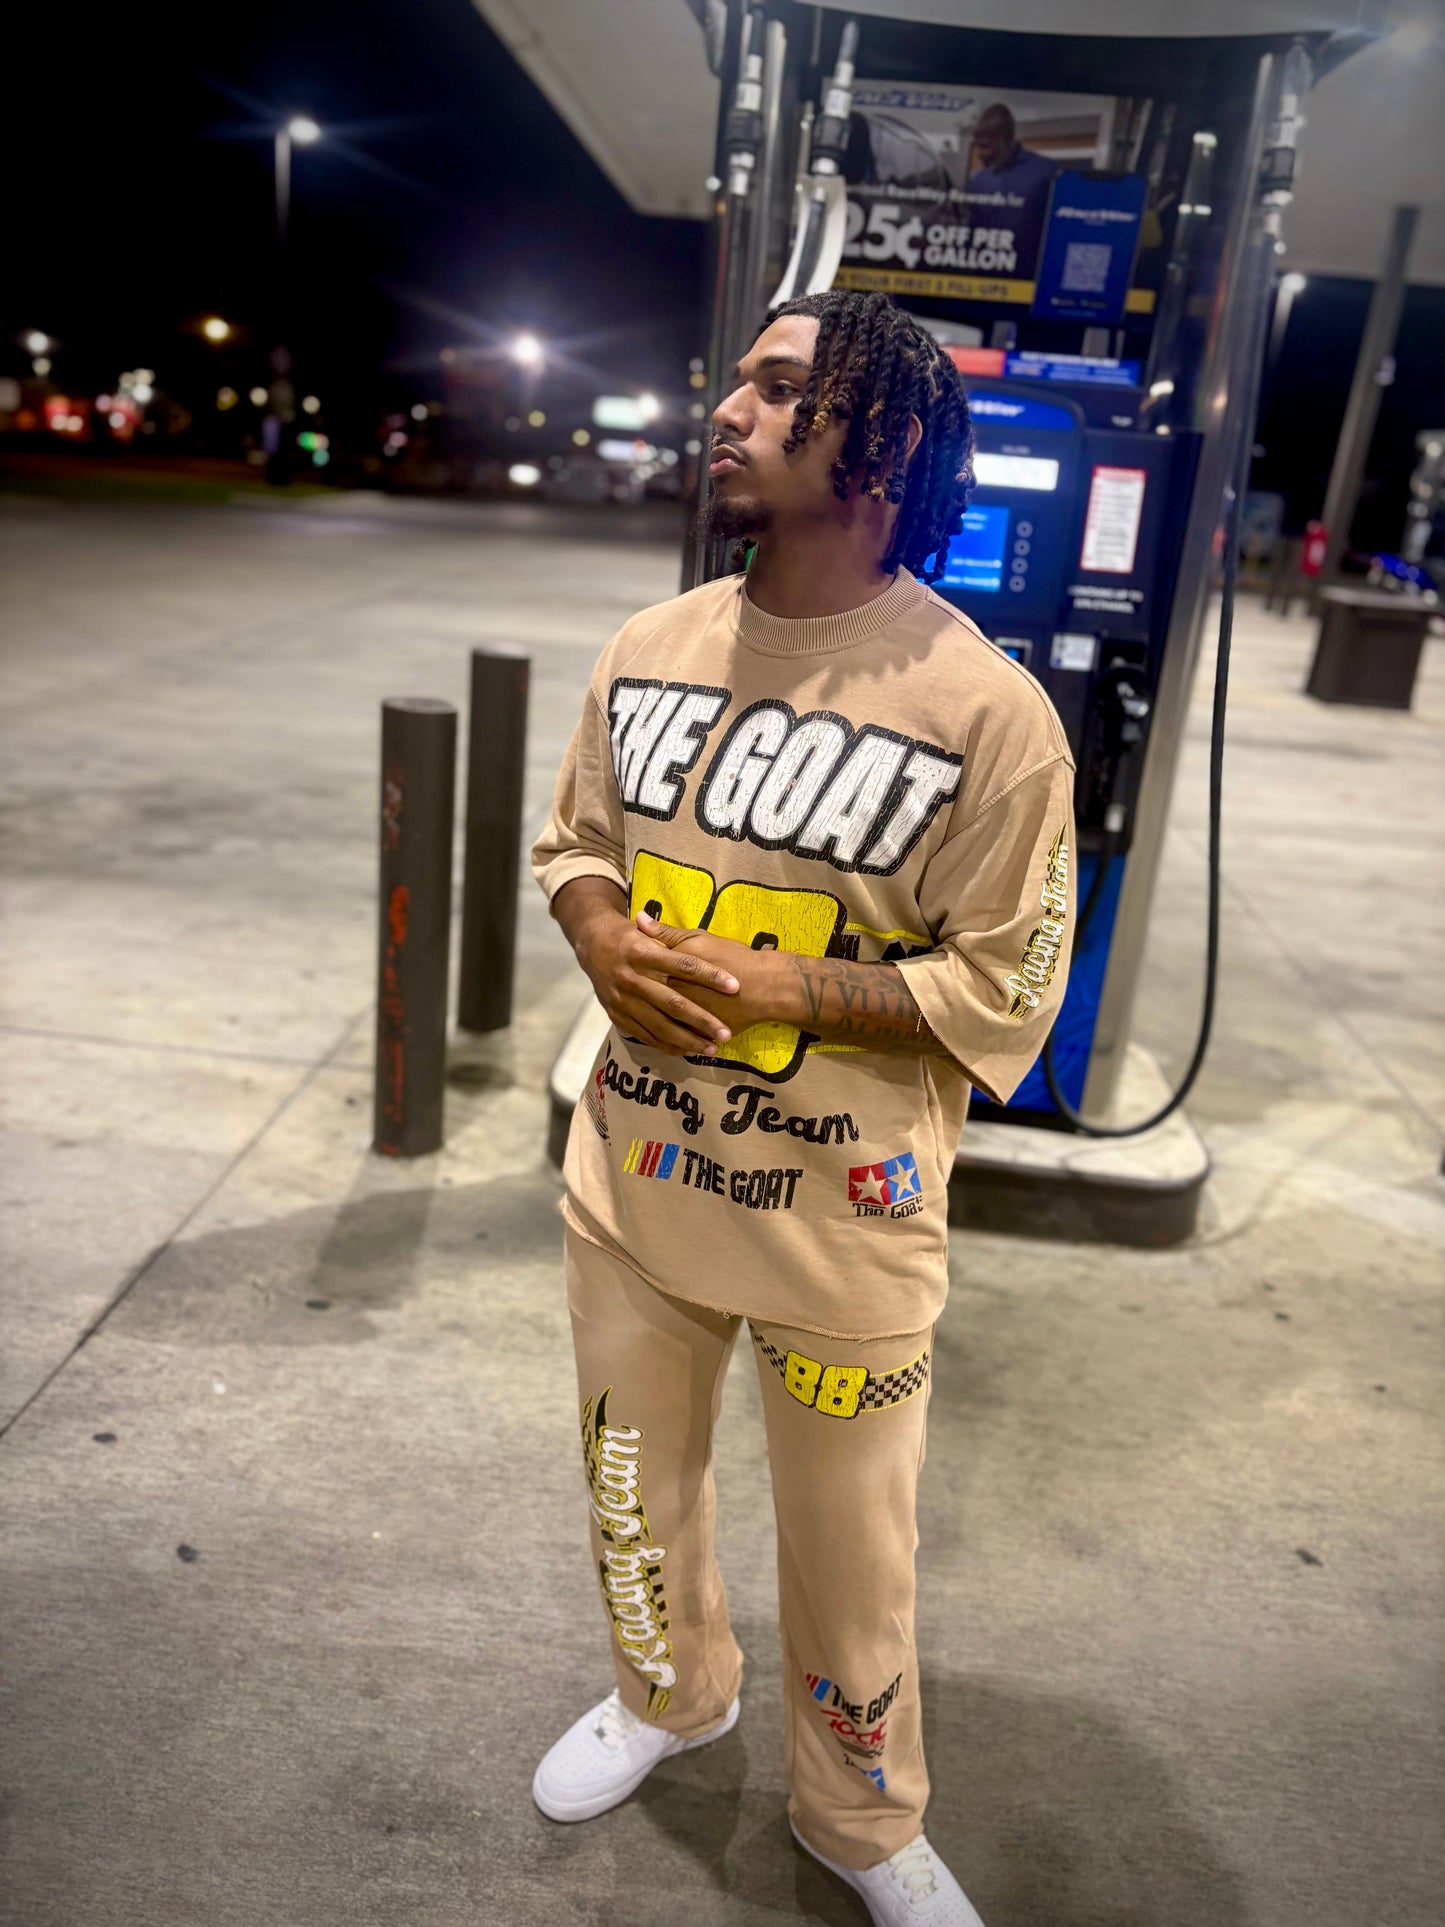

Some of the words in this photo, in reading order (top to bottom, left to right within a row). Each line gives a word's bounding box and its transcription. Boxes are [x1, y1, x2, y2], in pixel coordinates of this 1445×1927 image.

[924, 246, 1018, 271] GALLON
[926, 224, 970, 246] OFF
[973, 227, 1016, 249] PER
[609, 678, 732, 821] THE
[695, 699, 964, 876] GOAT
[1041, 844, 1069, 913] Team
[605, 1058, 704, 1135] acing
[720, 1085, 860, 1145] Team
[682, 1148, 725, 1196] THE
[730, 1168, 804, 1211] GOAT
[852, 1202, 887, 1217] The
[784, 1350, 871, 1420] 88
[590, 1424, 644, 1538] Team
[604, 1545, 678, 1689] Racing
[866, 1671, 903, 1725] GOAT
